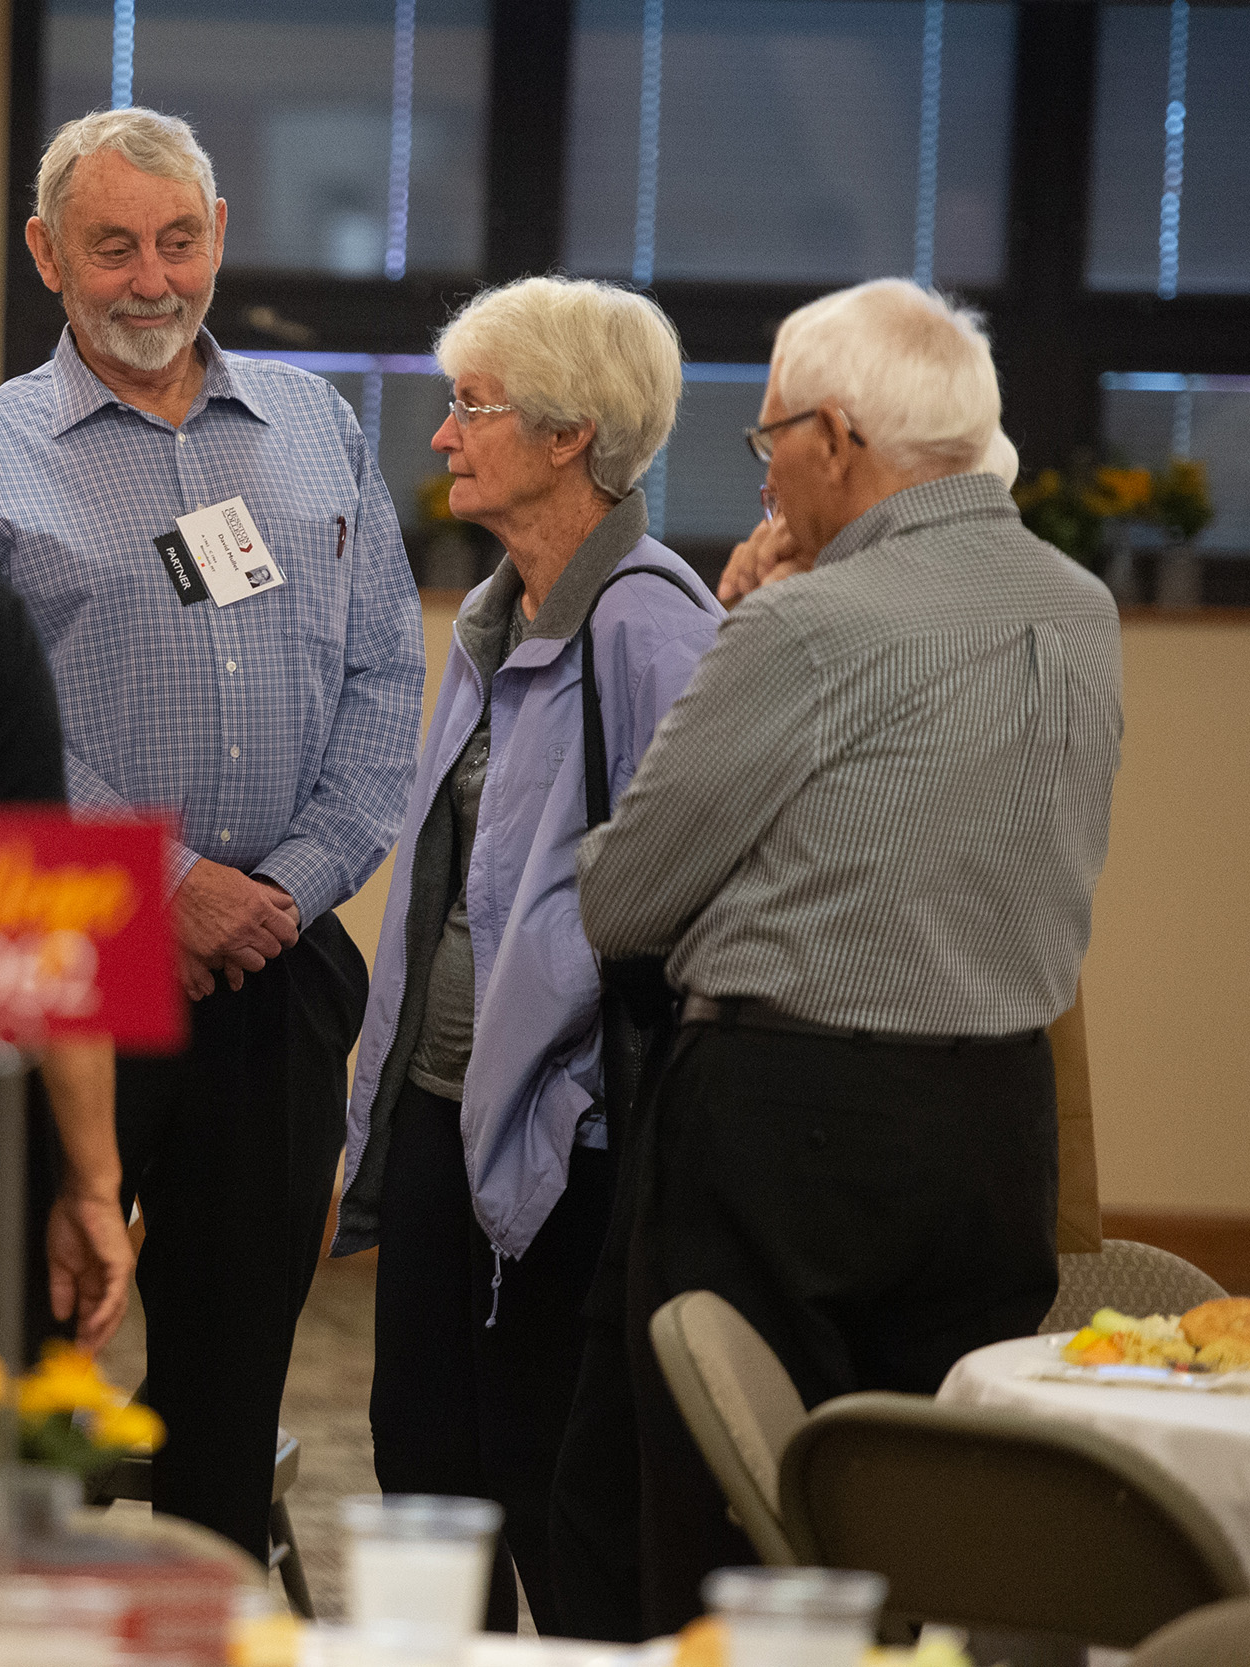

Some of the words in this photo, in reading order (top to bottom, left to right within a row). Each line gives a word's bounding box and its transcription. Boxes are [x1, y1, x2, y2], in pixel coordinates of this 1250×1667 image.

[225, 508, 247, 545] COLLEGE
[230, 506, 251, 544] HESSTON
[166, 546, 191, 591] PARTNER
[218, 533, 230, 552] David
[227, 551, 239, 571] Mullet
